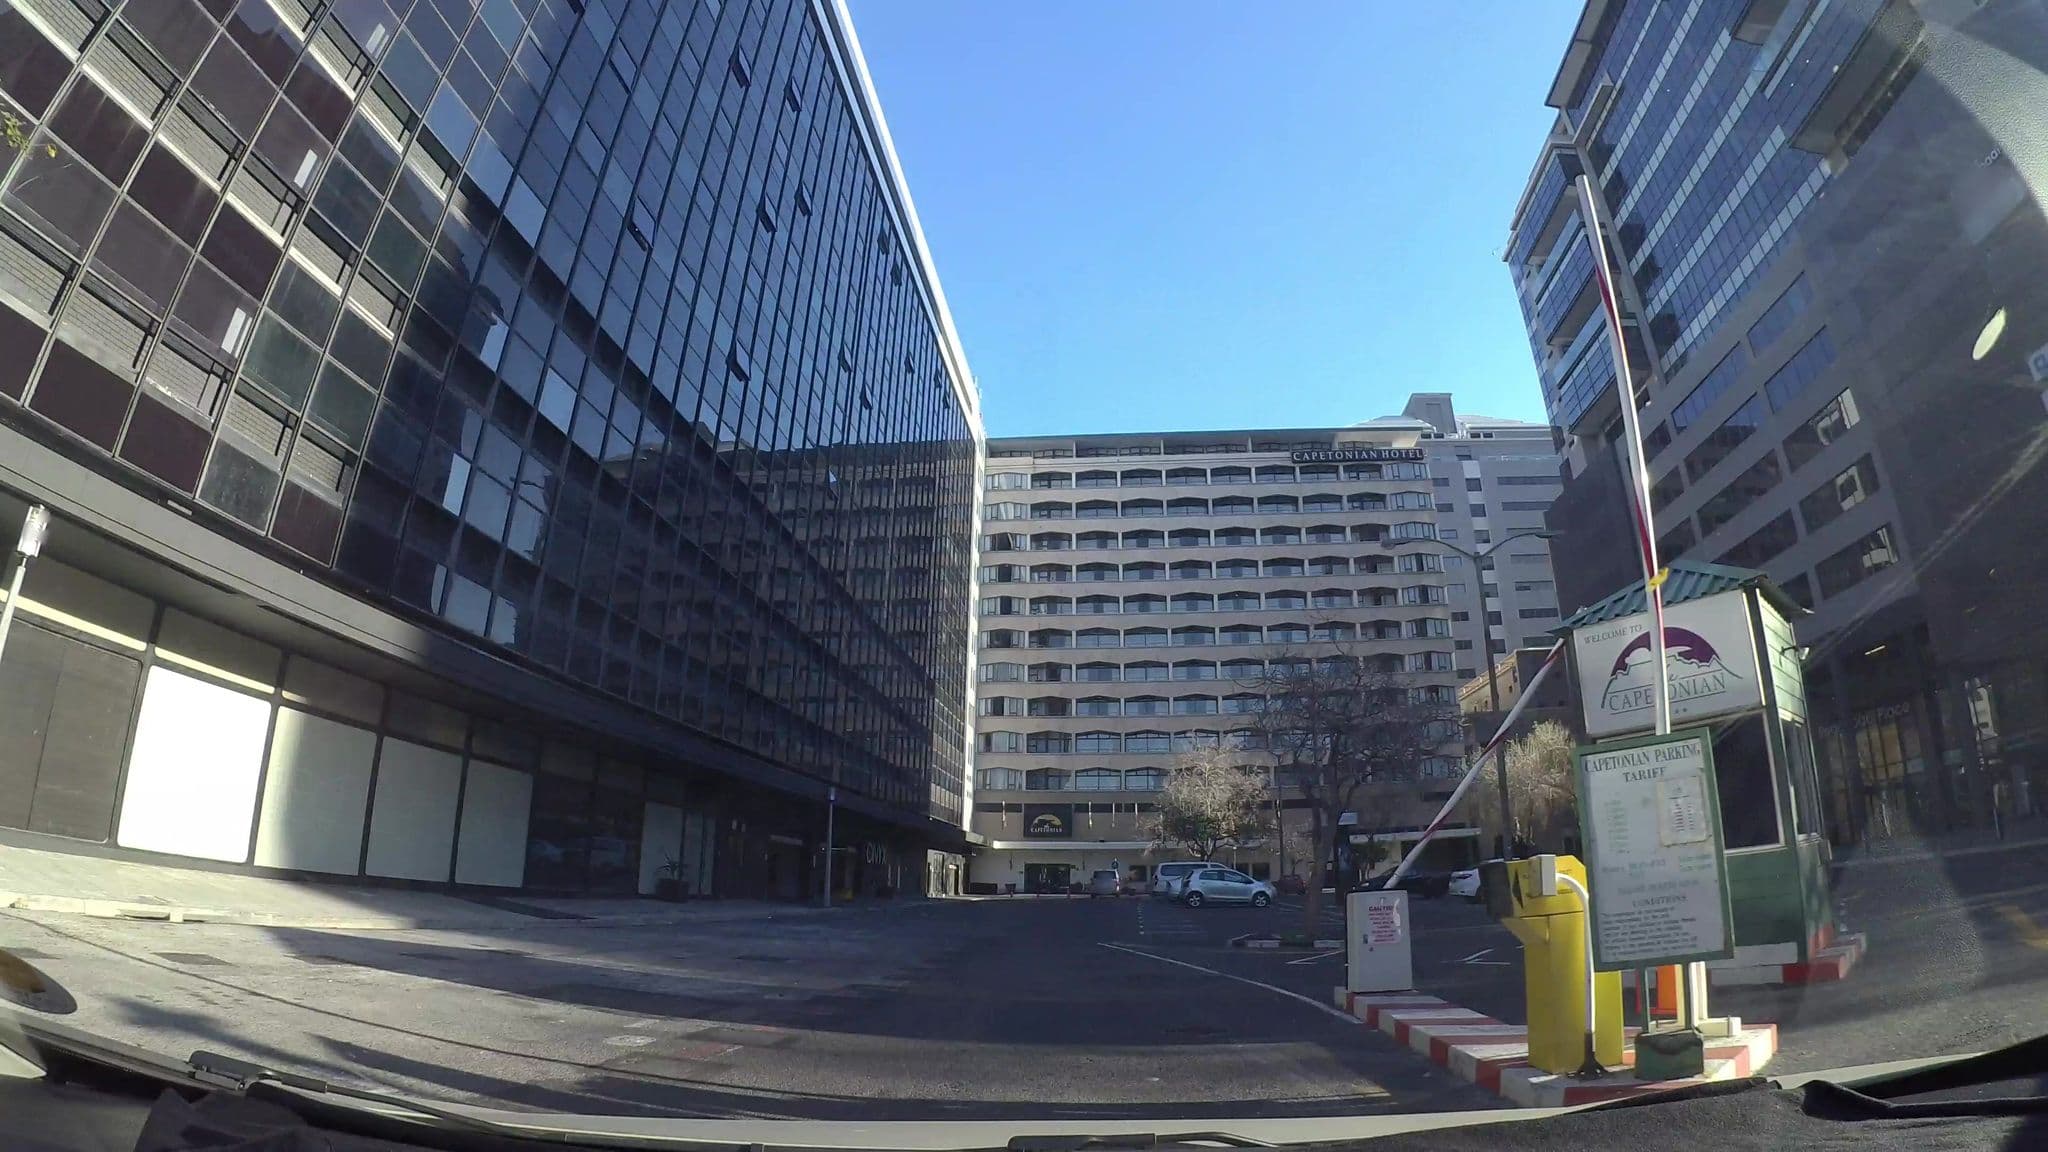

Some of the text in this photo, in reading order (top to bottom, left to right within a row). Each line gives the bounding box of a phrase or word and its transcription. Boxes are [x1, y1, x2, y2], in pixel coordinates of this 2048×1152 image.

[1293, 448, 1423, 461] CAPETONIAN HOTEL
[1584, 624, 1642, 644] WELCOME TO
[1608, 672, 1727, 711] CAPEONIAN
[1585, 751, 1651, 773] CAPETONIAN
[1622, 767, 1665, 782] TARIFF
